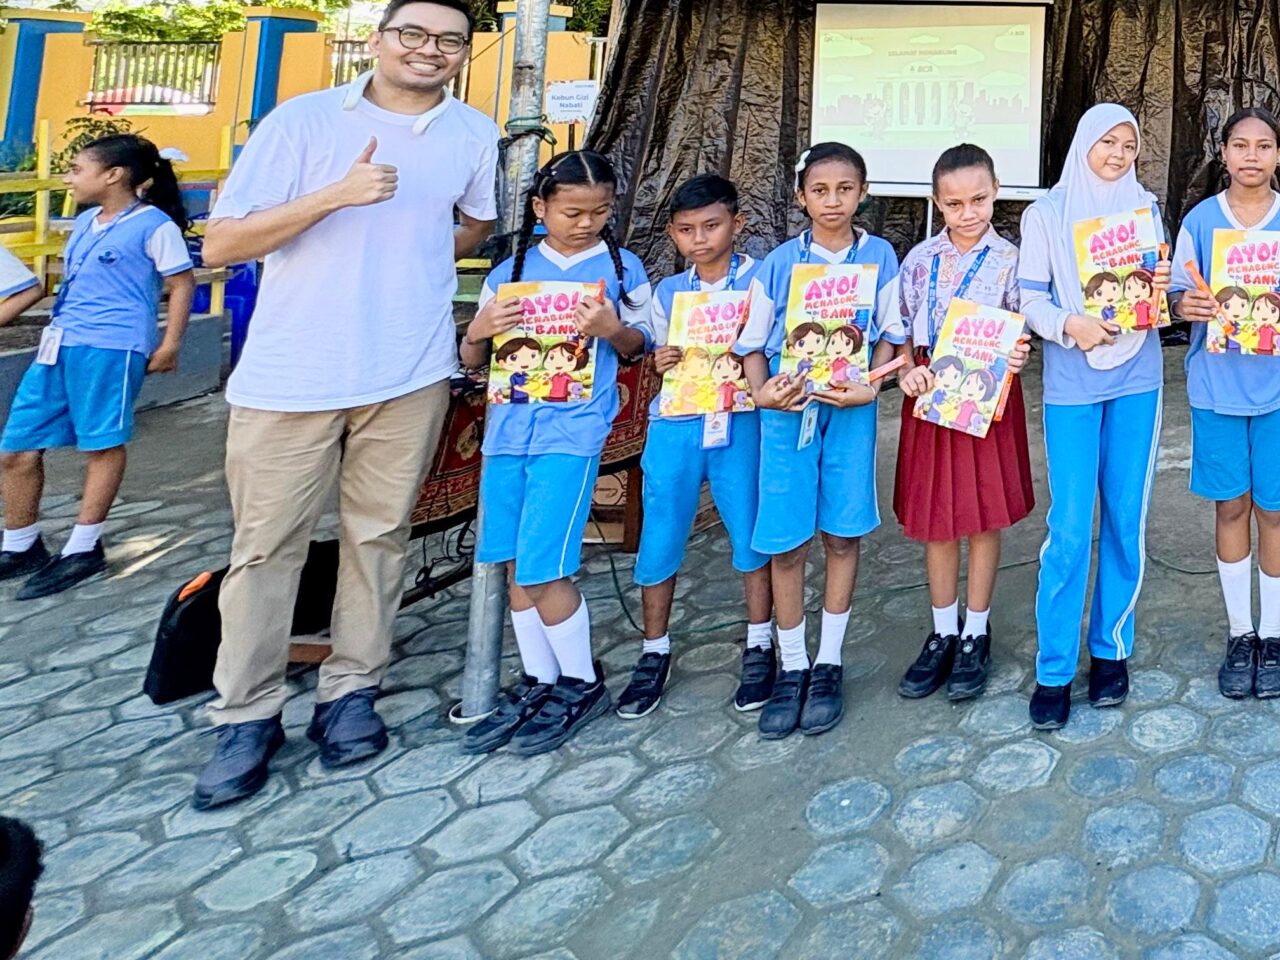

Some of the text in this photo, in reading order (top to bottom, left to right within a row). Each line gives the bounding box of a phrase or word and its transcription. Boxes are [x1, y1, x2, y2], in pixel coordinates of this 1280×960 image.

[1089, 219, 1136, 254] AYO!
[1092, 239, 1140, 262] MENABUNG
[1226, 240, 1279, 265] AYO!
[1109, 253, 1142, 269] BANK
[1227, 262, 1280, 274] MENABUNG
[804, 273, 859, 301] AYO!
[1243, 274, 1278, 286] BANK
[521, 290, 580, 316] AYO!
[804, 294, 859, 310] MENABUNG
[687, 300, 745, 327] AYO!
[820, 308, 855, 319] BANK
[535, 324, 578, 335] BANK
[954, 316, 1006, 340] AYO!
[951, 336, 1001, 349] MENABUNG
[963, 346, 996, 363] BANK
